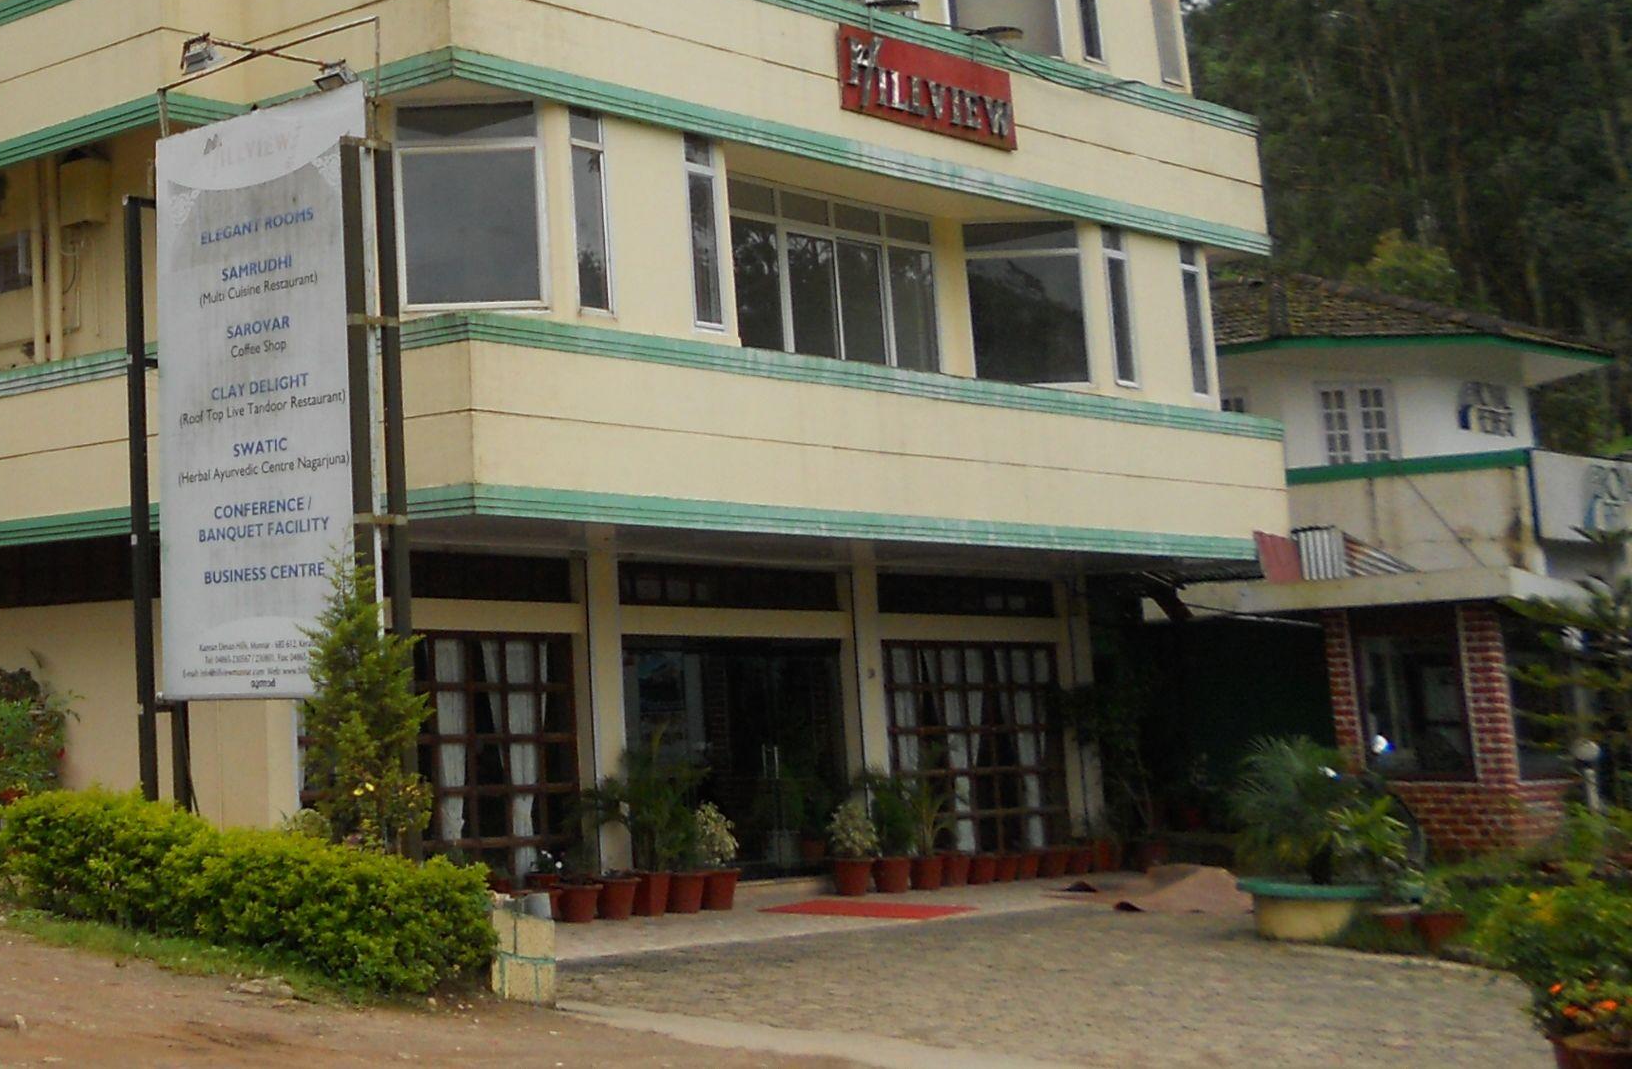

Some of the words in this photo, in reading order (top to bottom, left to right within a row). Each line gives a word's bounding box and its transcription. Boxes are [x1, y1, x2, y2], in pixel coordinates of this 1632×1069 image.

[847, 36, 1012, 137] HILLVIEW
[200, 219, 259, 245] ELEGANT
[264, 207, 314, 229] ROOMS
[221, 255, 292, 281] SAMRUDHI
[227, 284, 261, 300] Cuisine
[263, 273, 318, 292] Restaurant)
[226, 316, 290, 339] SAROVAR
[230, 342, 261, 358] Coffee
[264, 338, 287, 356] Shop
[211, 380, 246, 401] CLAY
[249, 373, 309, 395] DELIGHT
[179, 410, 204, 428] (Roof
[205, 408, 224, 422] Top
[227, 404, 244, 418] Live
[247, 399, 287, 415] Tandoor
[290, 390, 346, 410] Restaurant)
[233, 437, 288, 458] SWATIC
[178, 469, 211, 487] (Herbal
[213, 464, 258, 483] Ayurvedic
[261, 460, 295, 474] Centre
[297, 451, 350, 472] Nagarjuna)
[213, 497, 304, 520] CONFERENCE
[198, 521, 263, 543] BANQUET
[267, 516, 330, 537] FACILITY
[204, 567, 267, 584] BUSINESS
[270, 562, 325, 579] CENTRE
